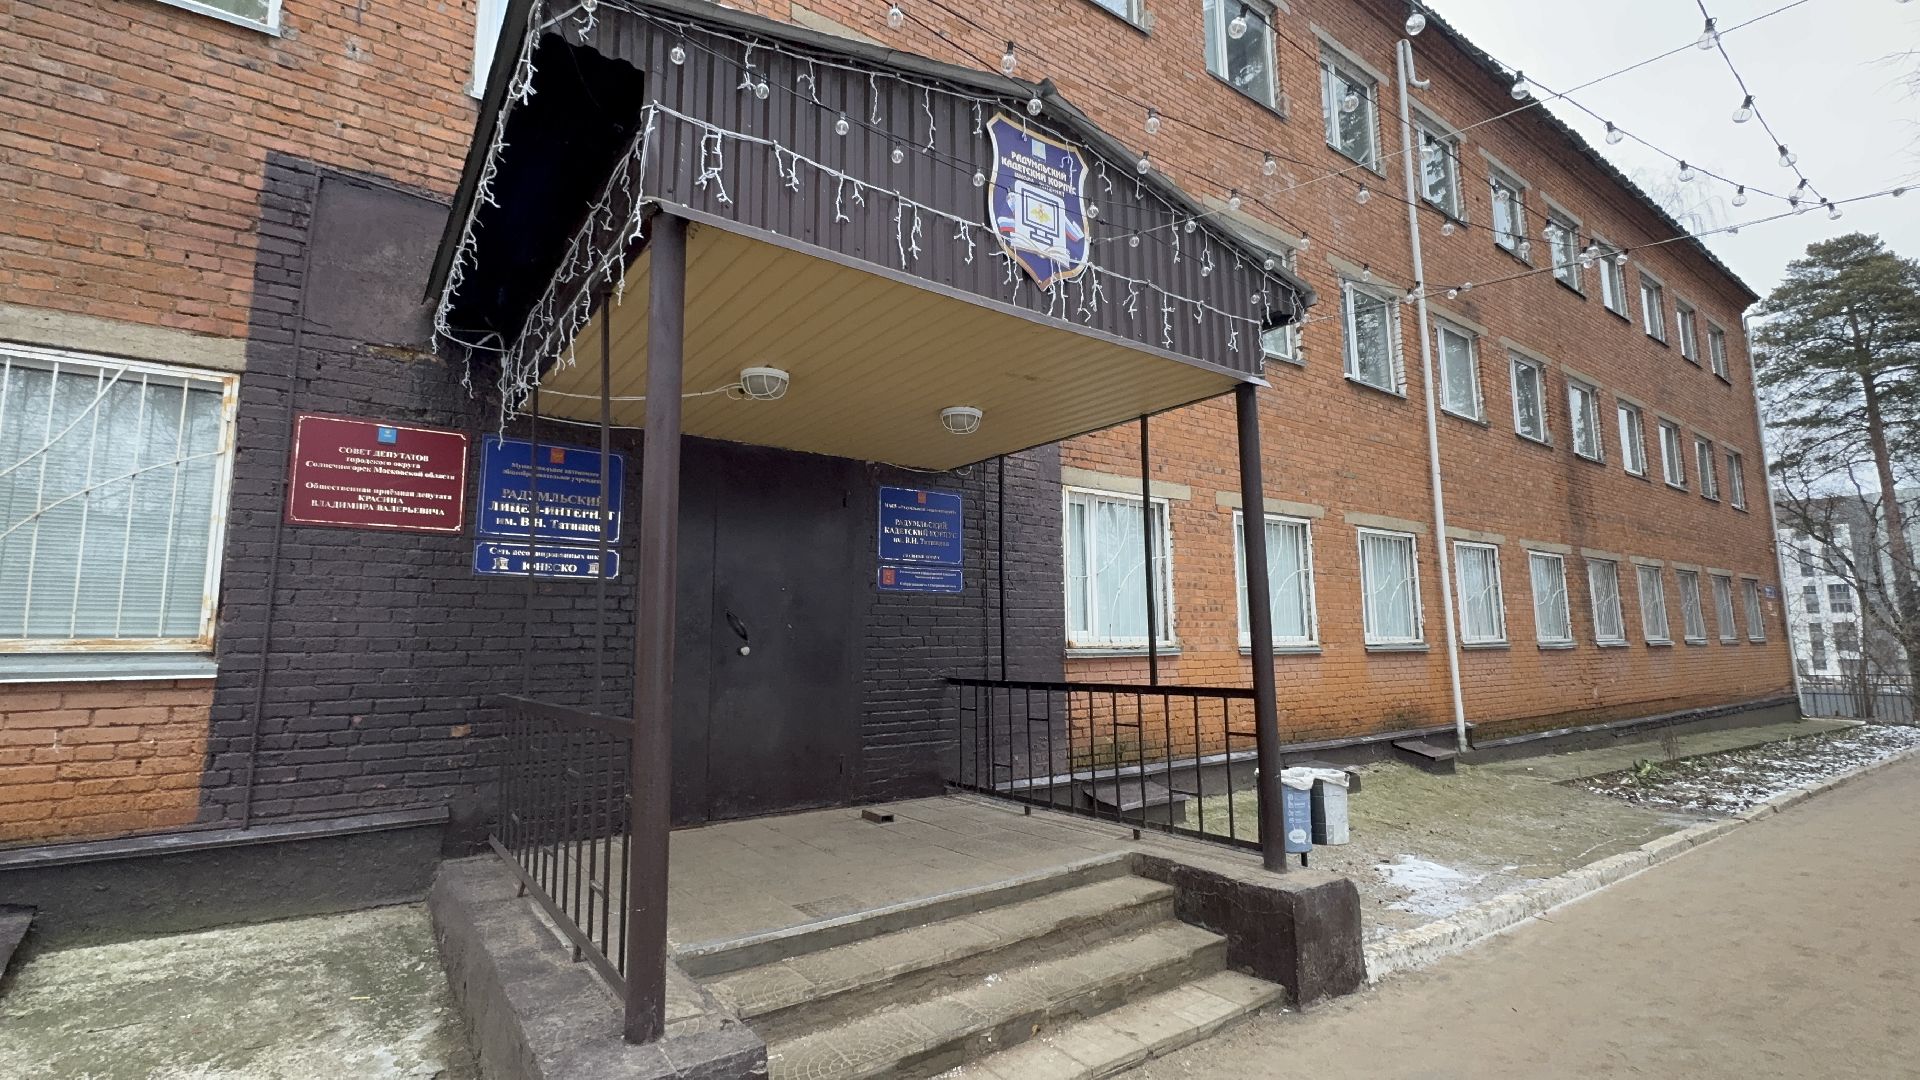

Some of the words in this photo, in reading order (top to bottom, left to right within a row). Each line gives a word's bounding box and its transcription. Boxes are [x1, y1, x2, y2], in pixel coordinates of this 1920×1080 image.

[1001, 156, 1047, 182] КАДЕТСКИЙ
[1048, 176, 1076, 195] КОРПУС
[338, 446, 371, 456] СОВЕТ
[373, 451, 429, 462] ДЕПУТАТОВ
[346, 456, 392, 467] городского
[393, 462, 421, 470] округа
[373, 466, 424, 477] Московской
[425, 471, 455, 480] области
[305, 481, 372, 494] Общественная
[416, 492, 452, 501] депутата
[358, 494, 404, 505] КРАСИНА
[311, 499, 374, 511] ВЛАДИМИРА
[376, 505, 445, 516] ВАЛЕРЬЕВИЧА
[496, 517, 517, 526] им.
[550, 519, 601, 532] Татищев
[884, 526, 928, 537] КАДЕТСКИЙ
